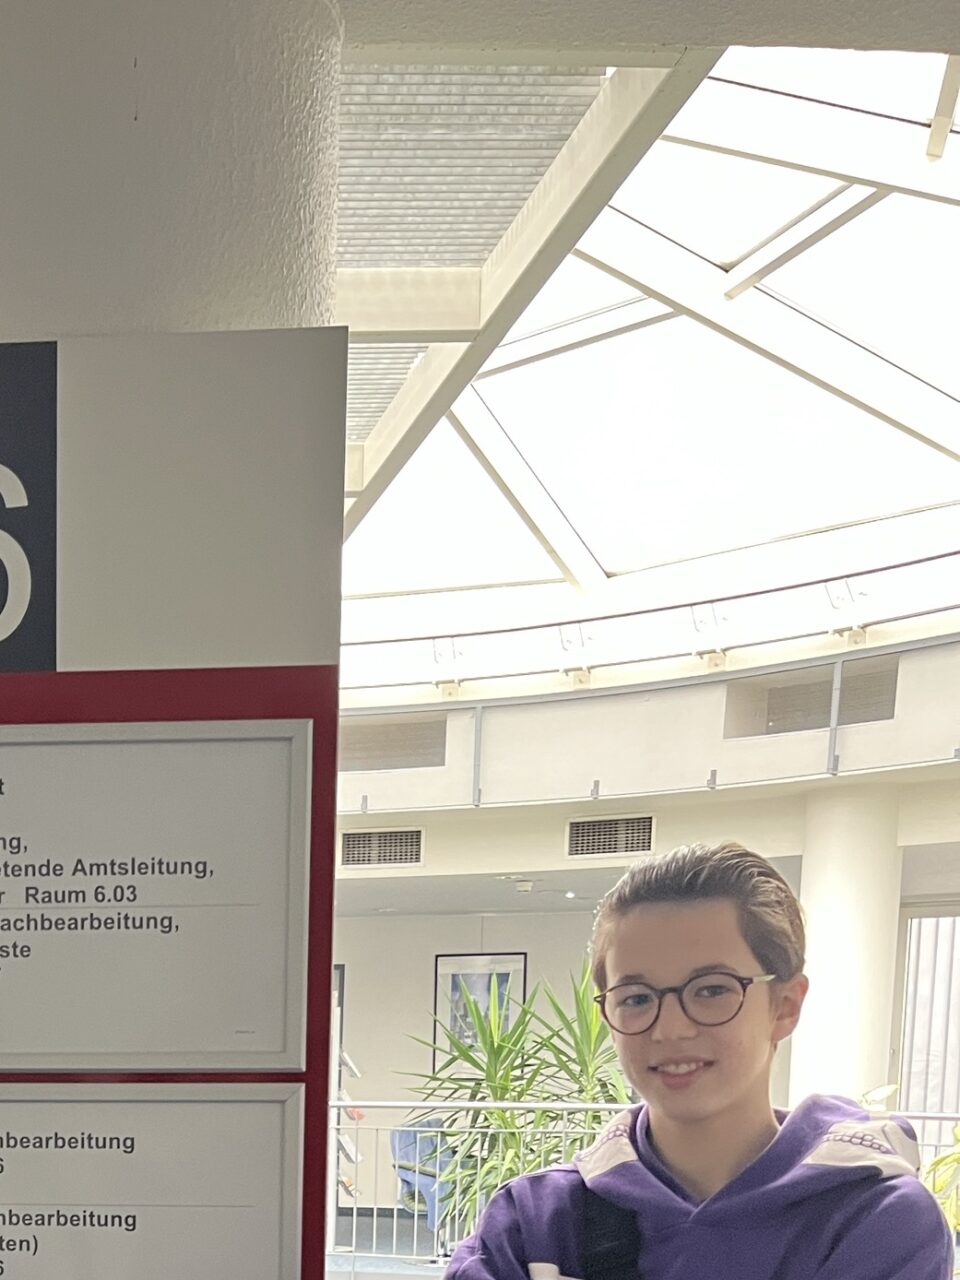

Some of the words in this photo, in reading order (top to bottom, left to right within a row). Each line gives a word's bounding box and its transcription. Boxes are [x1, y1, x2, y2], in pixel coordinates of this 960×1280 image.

[71, 856, 215, 879] Amtsleitung,
[25, 886, 86, 904] Raum
[94, 885, 138, 903] 6.03
